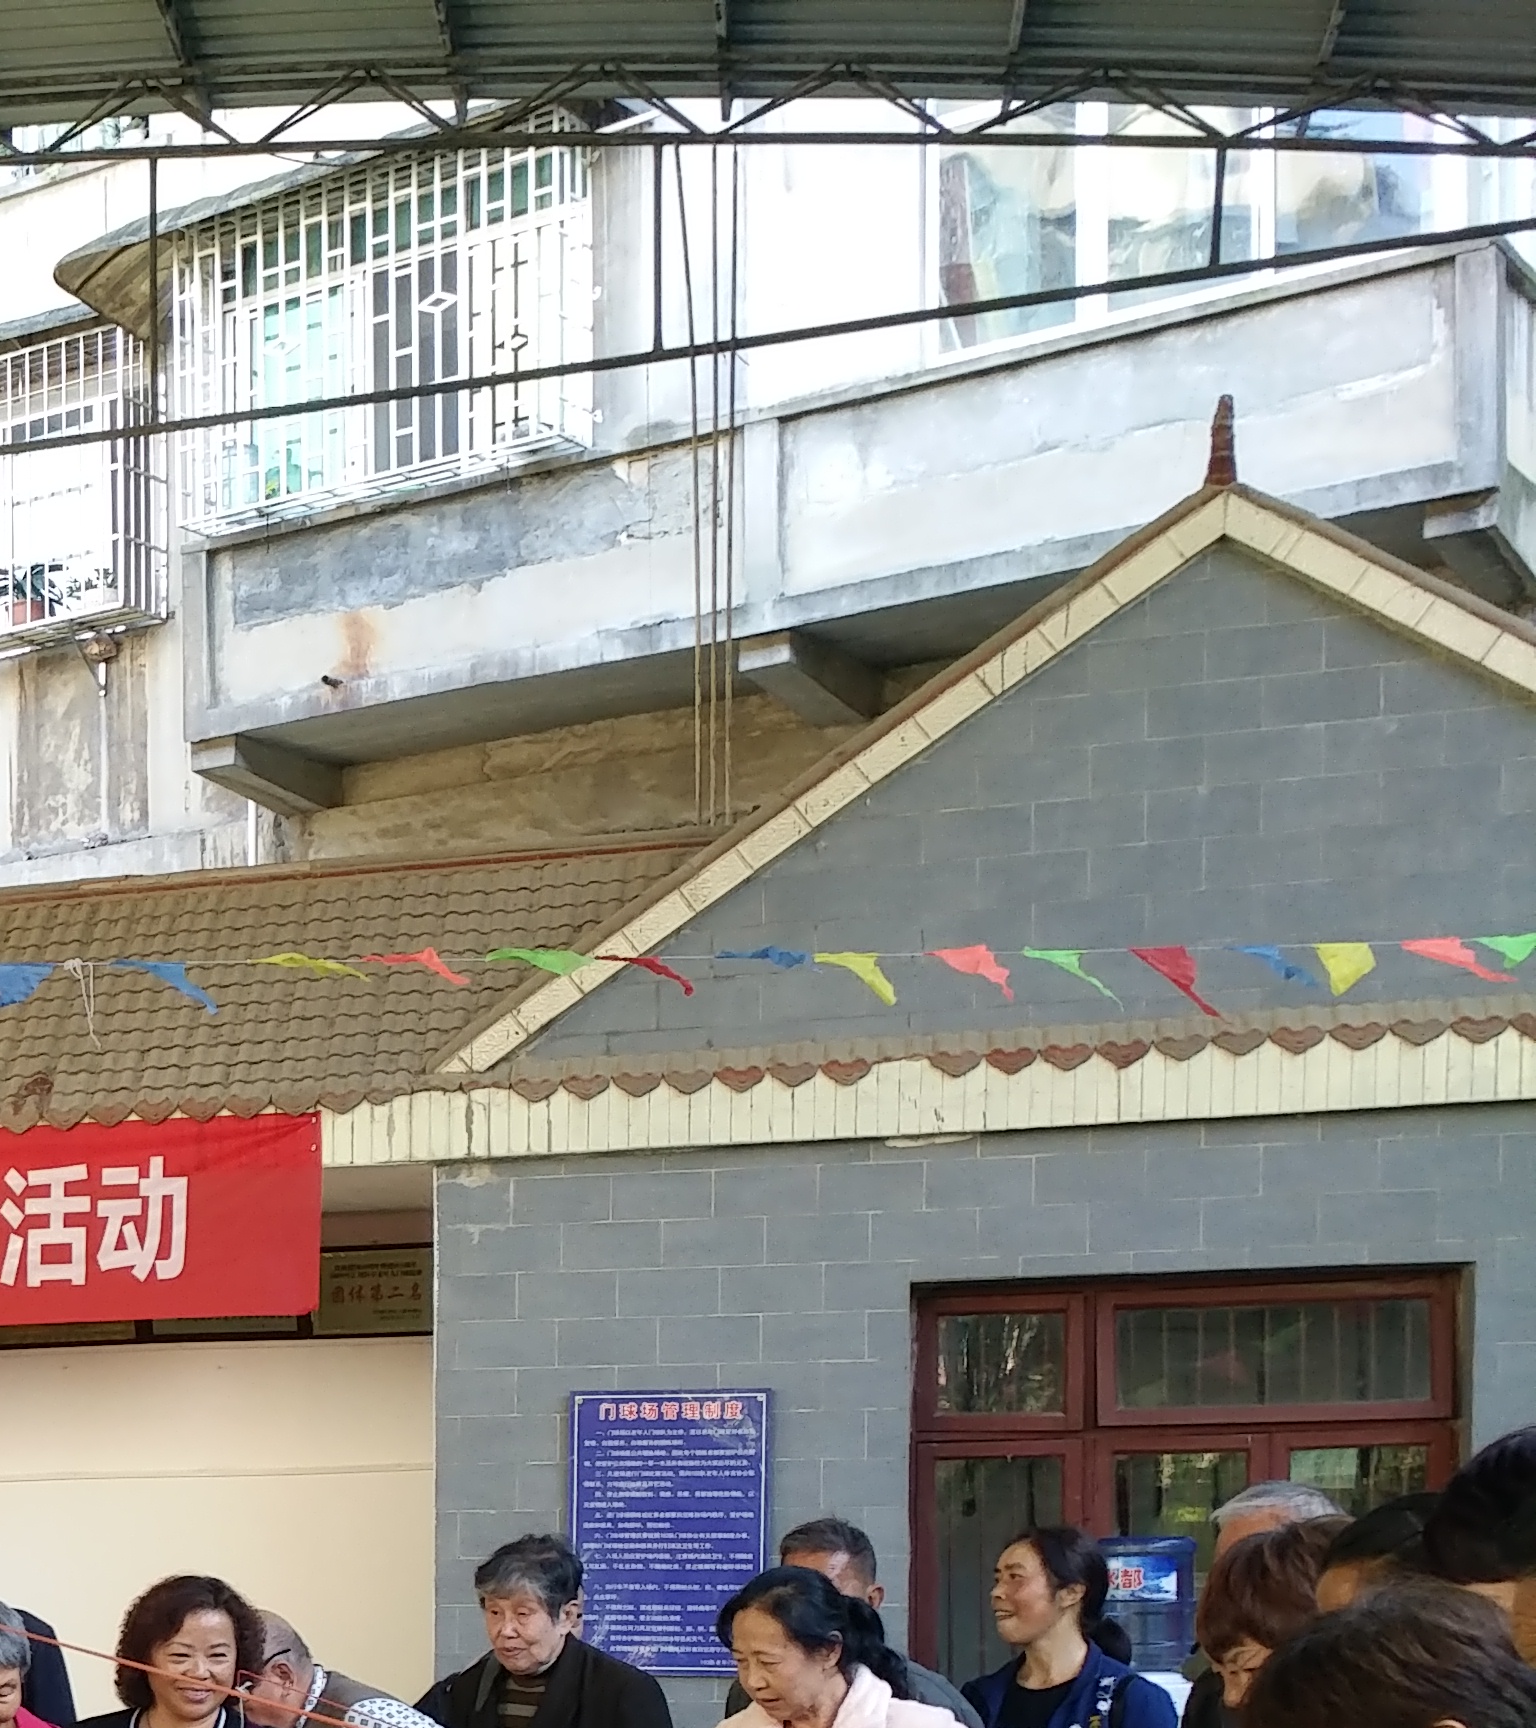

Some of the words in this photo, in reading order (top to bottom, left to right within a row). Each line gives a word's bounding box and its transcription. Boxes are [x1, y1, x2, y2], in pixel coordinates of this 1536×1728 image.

[599, 1401, 743, 1421] 门球场管理制度
